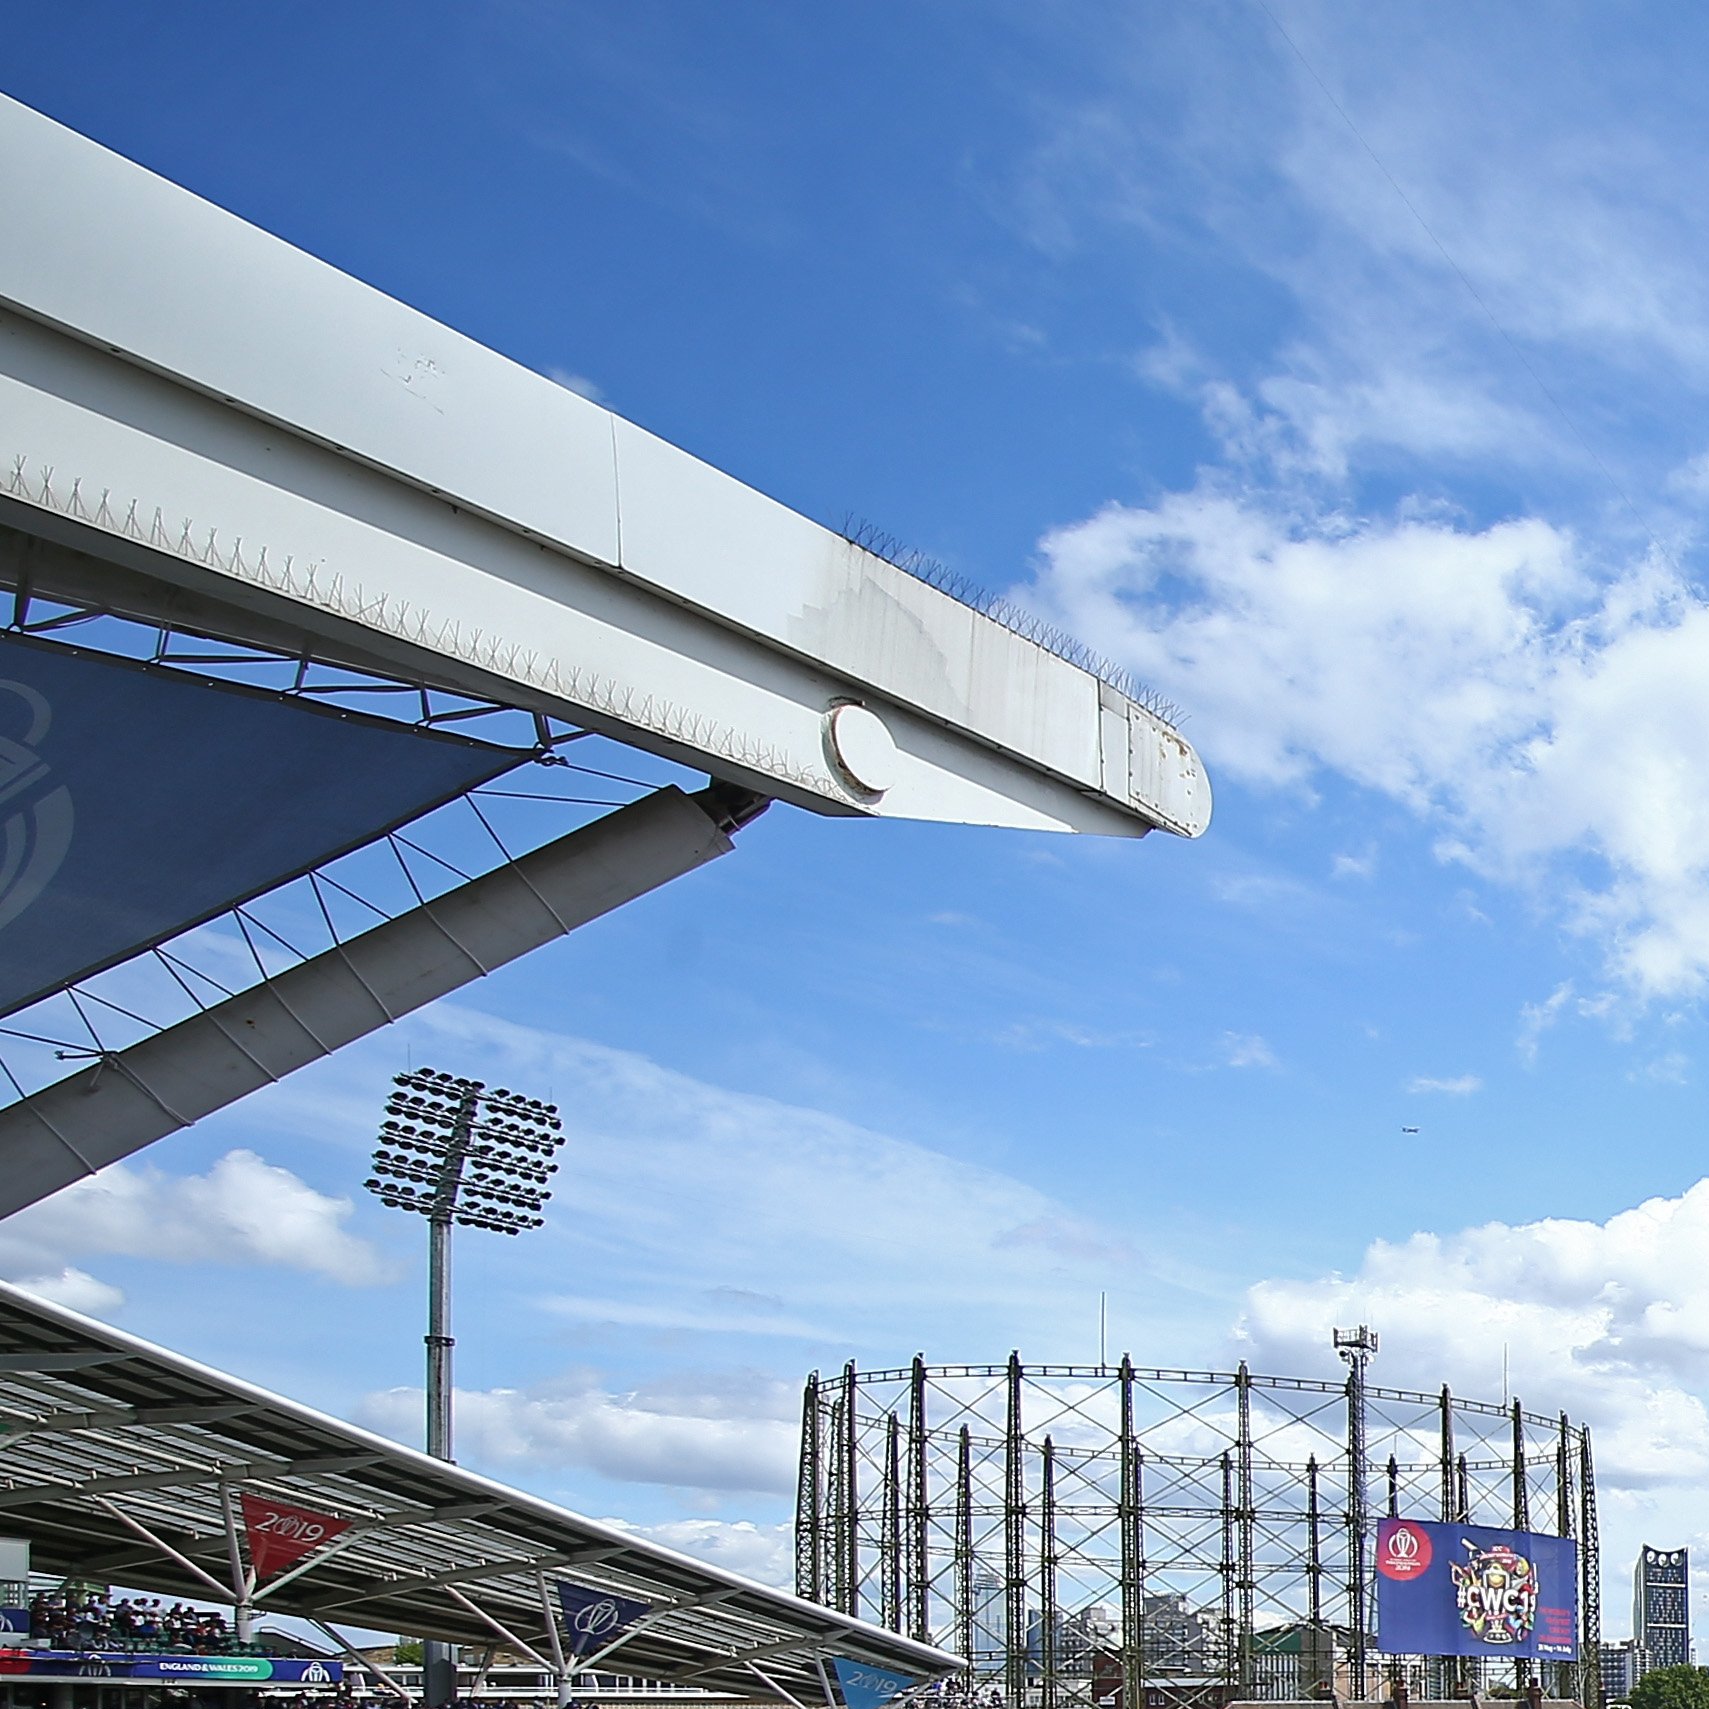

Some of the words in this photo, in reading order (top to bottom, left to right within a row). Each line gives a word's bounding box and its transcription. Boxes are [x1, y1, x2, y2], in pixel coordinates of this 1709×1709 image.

[255, 1512, 324, 1542] 2019
[1457, 1586, 1536, 1612] #CWC19
[159, 1663, 201, 1671] ENGLAND
[209, 1664, 238, 1673] WALES
[239, 1665, 258, 1673] 2019
